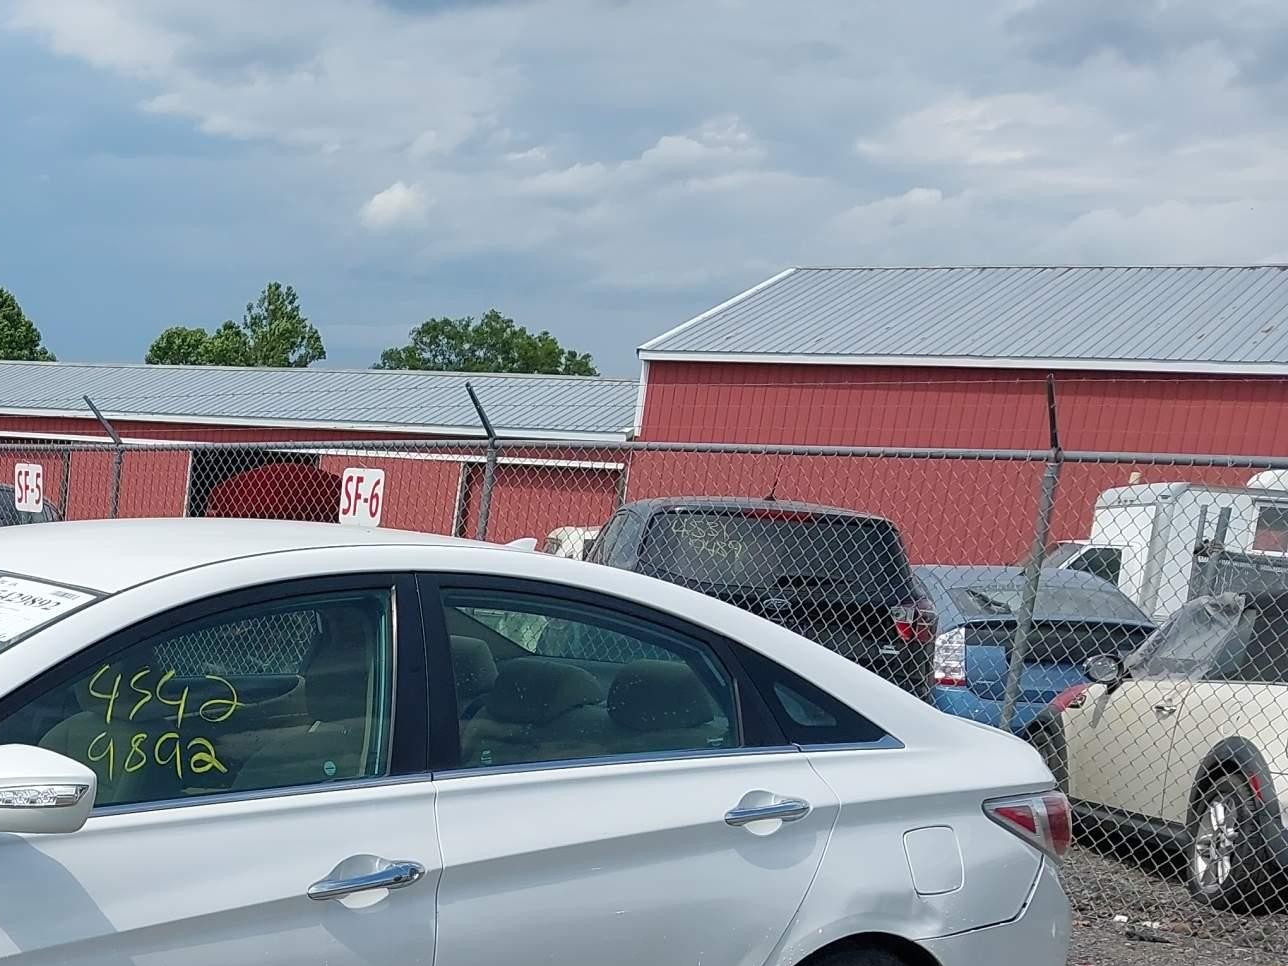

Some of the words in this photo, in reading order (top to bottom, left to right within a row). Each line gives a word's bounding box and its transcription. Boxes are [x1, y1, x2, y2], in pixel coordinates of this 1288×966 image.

[17, 470, 41, 504] SF-5
[342, 475, 381, 517] SF-6
[88, 664, 248, 729] 4542
[88, 731, 228, 780] 9892
